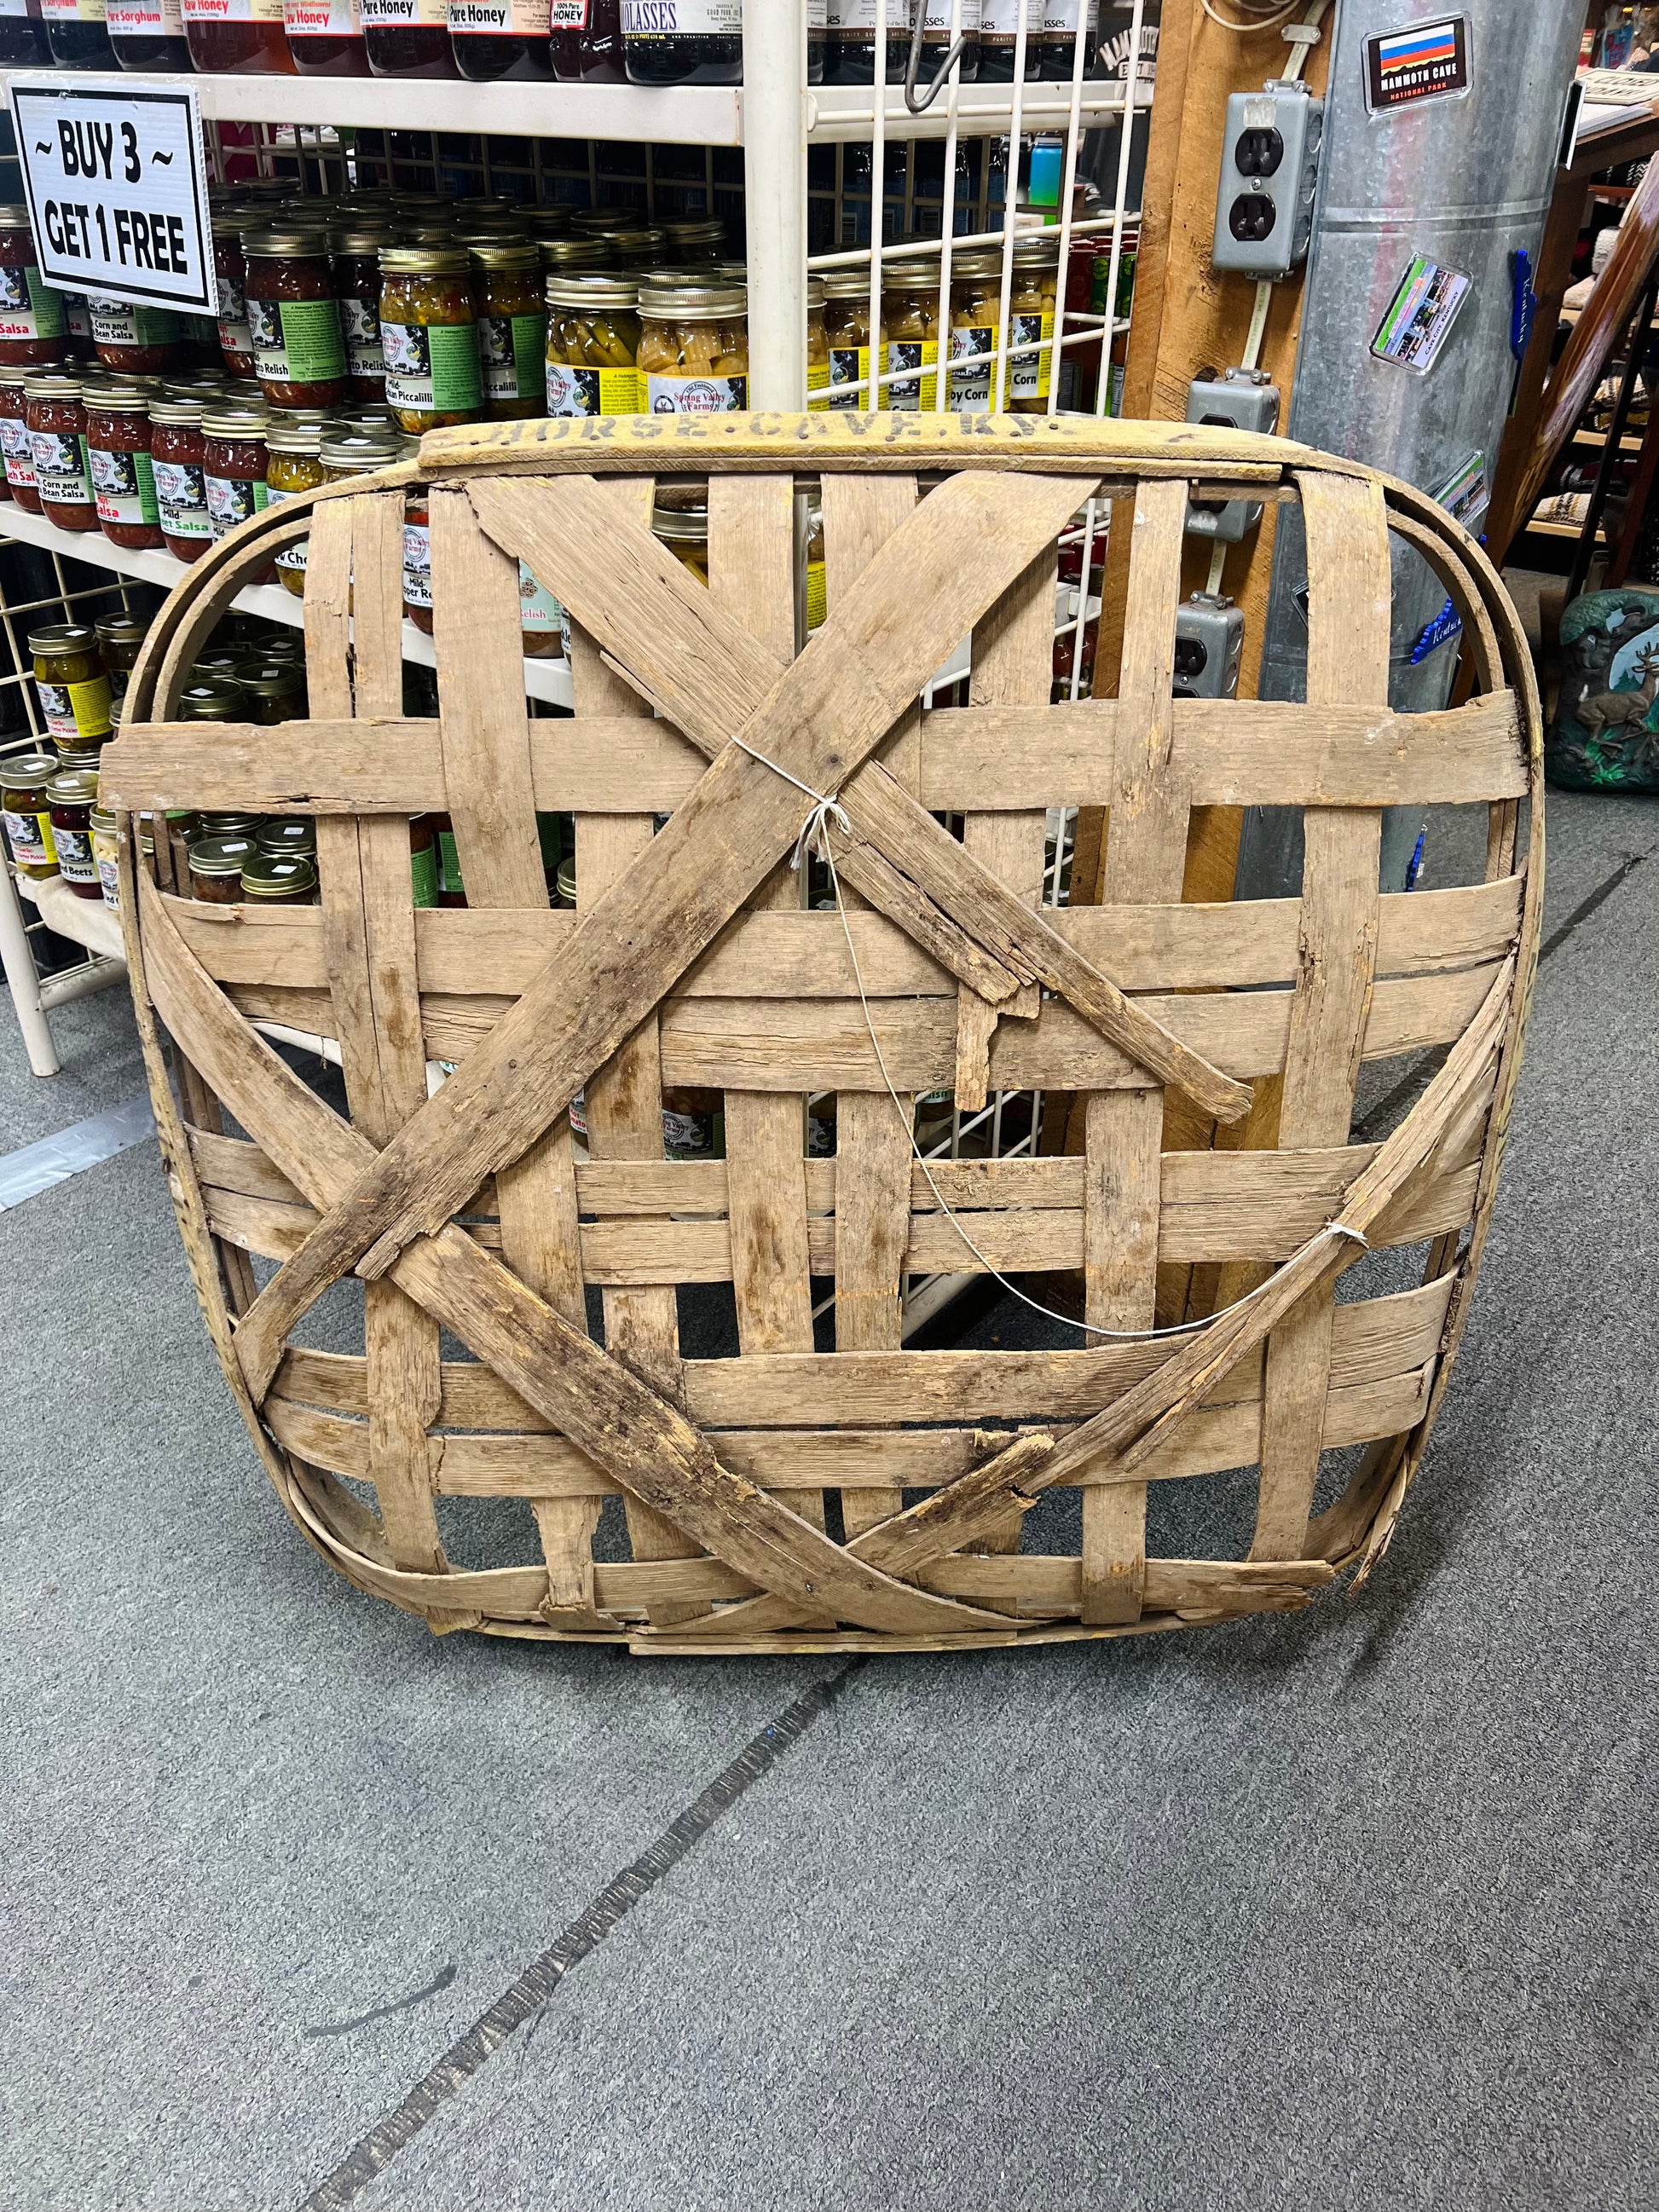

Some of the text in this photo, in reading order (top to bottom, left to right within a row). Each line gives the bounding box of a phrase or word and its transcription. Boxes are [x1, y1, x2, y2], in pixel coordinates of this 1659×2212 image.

[198, 0, 228, 14] Honey
[363, 0, 378, 14] Pure
[381, 0, 413, 18] Honey
[120, 10, 160, 25] Sorghum
[296, 9, 330, 27] Honey
[449, 8, 466, 22] Pure
[469, 5, 506, 26] Honey
[553, 10, 583, 20] HONEY
[1381, 63, 1457, 91] MAMMOTH CAVE
[1390, 82, 1447, 101] NATIONAL PARK
[57, 119, 113, 179] BUY
[121, 122, 141, 183] 3
[44, 199, 188, 274] GET 1 FREE
[1517, 278, 1530, 343] Kentucky
[0, 323, 29, 333] Salsa
[95, 320, 128, 331] Corn and
[1425, 338, 1435, 355] CAVE
[1442, 292, 1460, 322] KENTUCKY
[96, 328, 134, 339] Bean Salsa
[265, 363, 288, 375] Relish
[1014, 373, 1037, 384] Corn
[695, 383, 714, 393] Fashioned
[398, 390, 433, 403] Piccalilli
[674, 392, 725, 403] Spring Valley
[965, 389, 988, 400] Corn
[489, 414, 708, 443] HORSE
[43, 479, 79, 490] Corn and
[43, 487, 85, 499] Bean Salsa
[175, 520, 209, 531] Salsa
[68, 866, 93, 876] Beets
